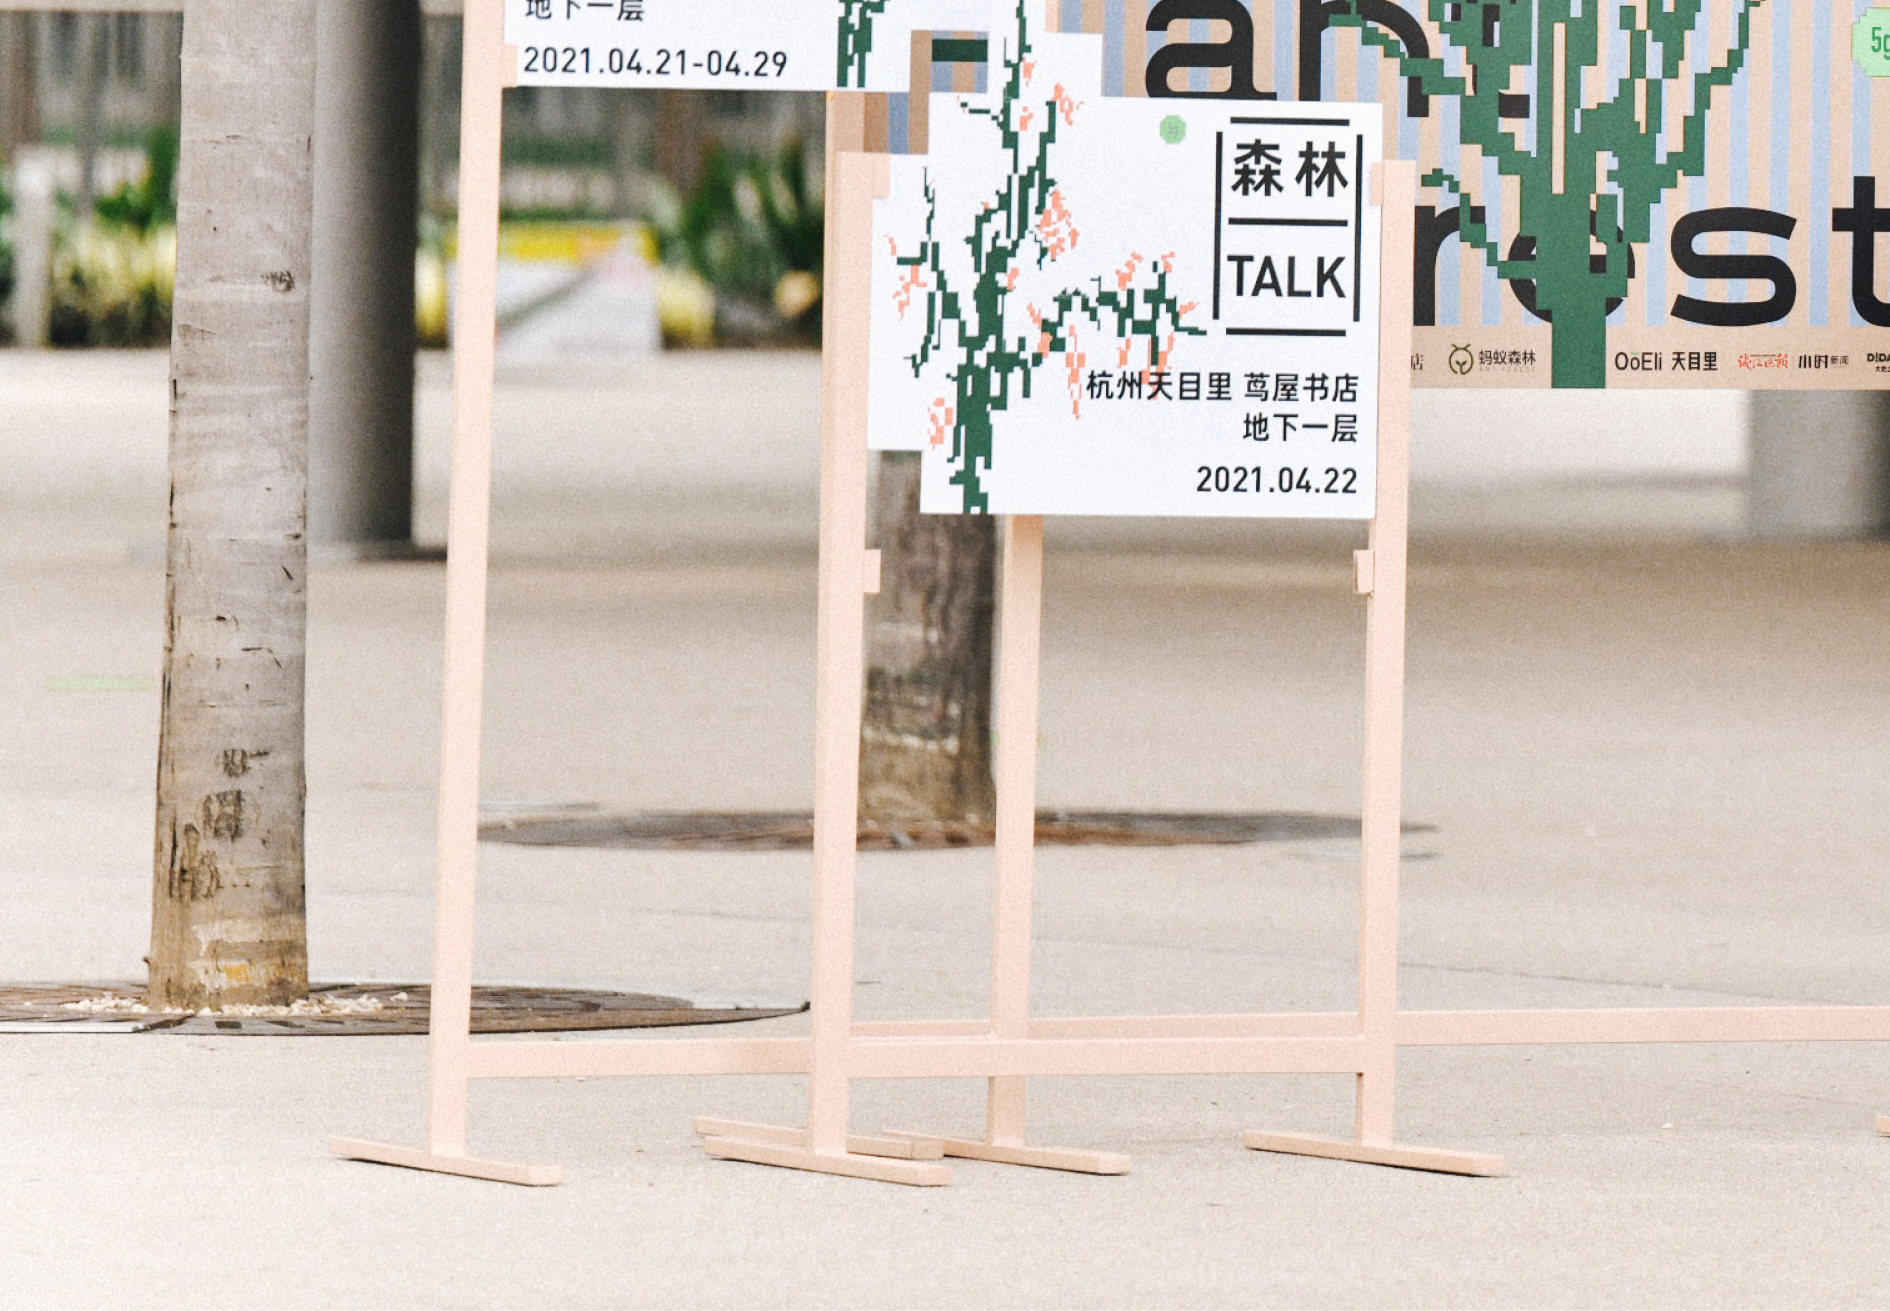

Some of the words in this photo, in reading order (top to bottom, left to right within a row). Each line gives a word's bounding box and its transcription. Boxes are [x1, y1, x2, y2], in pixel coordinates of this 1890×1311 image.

[524, 47, 787, 77] 2021.04.21-04.29
[1231, 139, 1348, 197] 森林
[1227, 255, 1345, 298] TALK
[1476, 347, 1538, 367] 蚂蚁森林
[1670, 349, 1719, 372] 天目里
[1085, 370, 1233, 402] 杭州天目里
[1244, 372, 1358, 402] 茑屋书店
[1243, 413, 1357, 442] 地下一层
[1197, 466, 1356, 493] 2021.04.22
